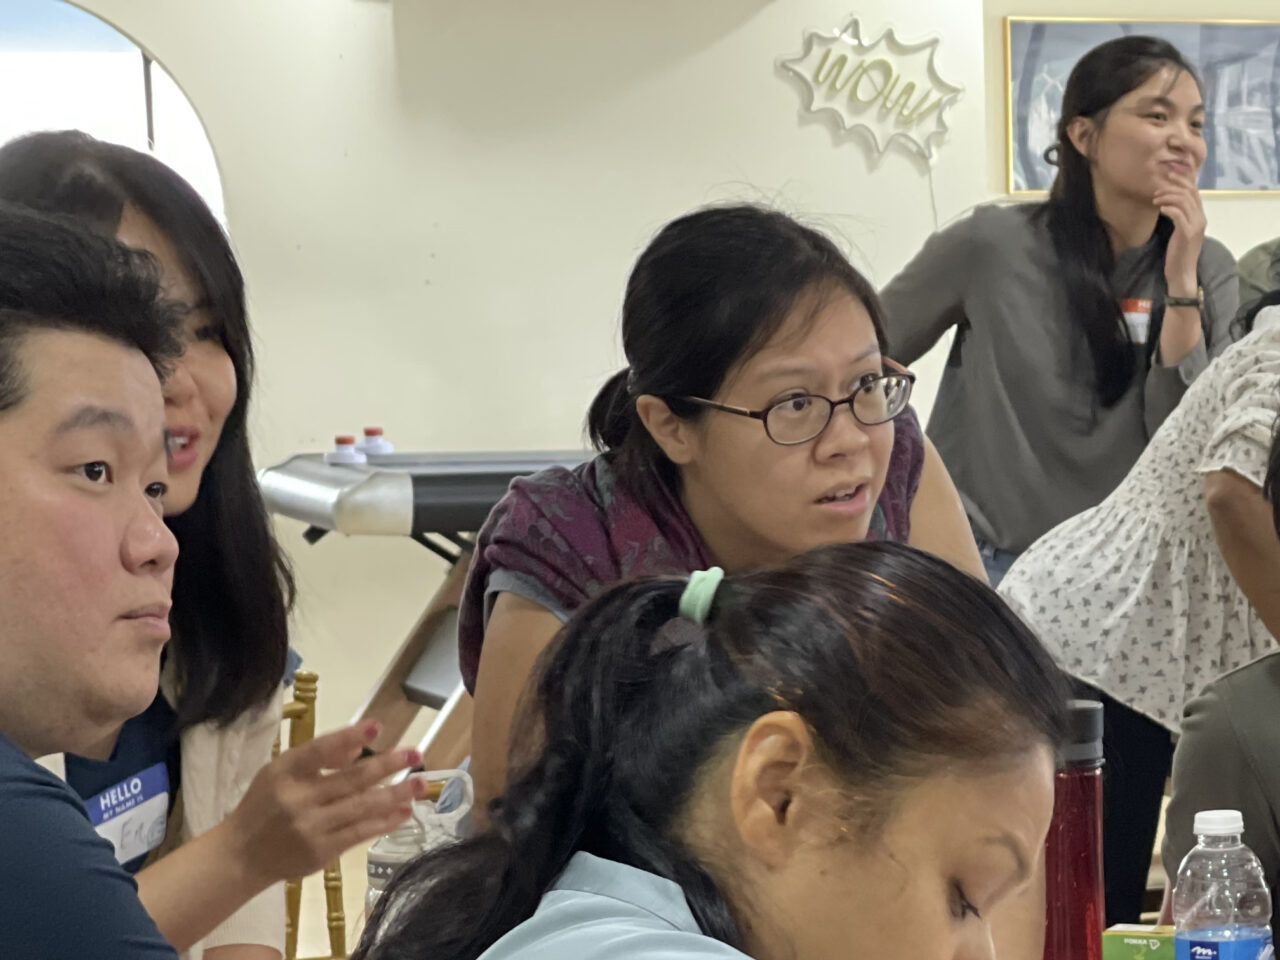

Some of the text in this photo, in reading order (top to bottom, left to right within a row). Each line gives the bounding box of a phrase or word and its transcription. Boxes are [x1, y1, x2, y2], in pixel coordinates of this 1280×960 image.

[100, 777, 142, 811] HELLO
[102, 794, 144, 820] MY NAME IS
